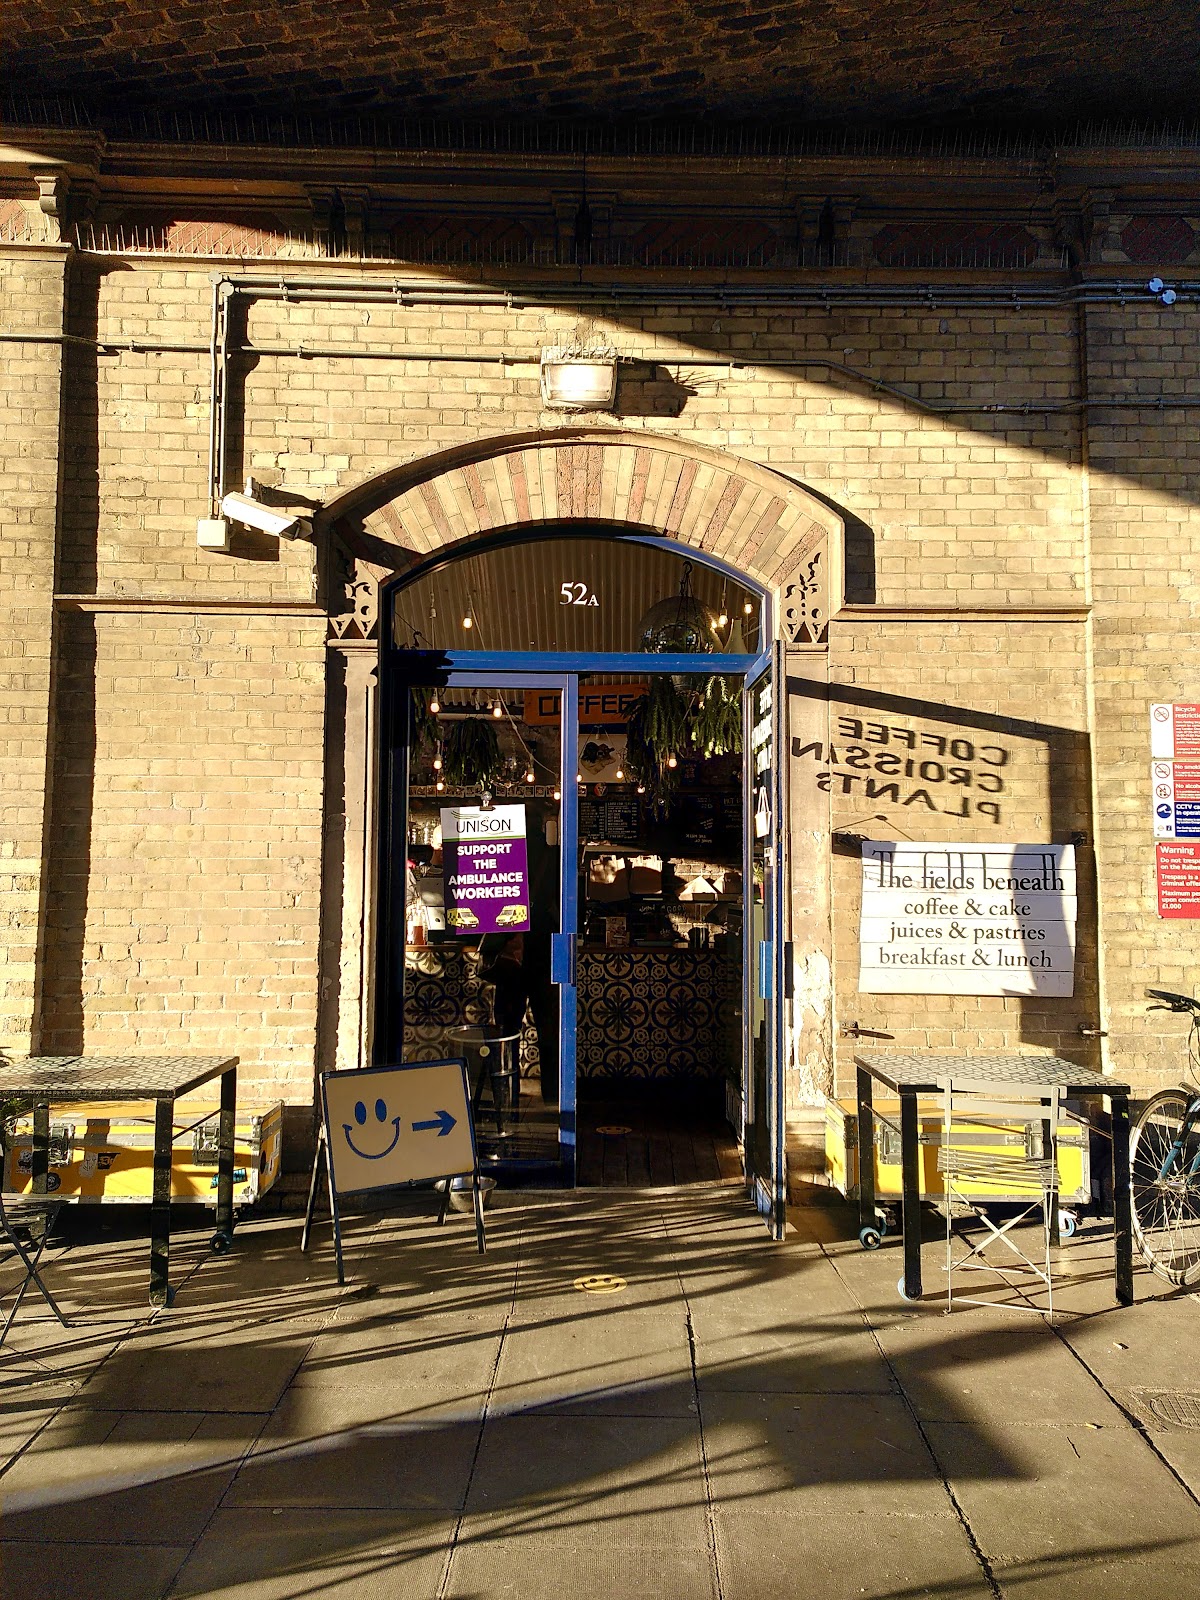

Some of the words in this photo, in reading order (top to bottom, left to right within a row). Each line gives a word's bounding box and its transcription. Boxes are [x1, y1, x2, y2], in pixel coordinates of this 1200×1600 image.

[559, 581, 600, 607] 52A
[456, 819, 511, 833] UNISON
[457, 843, 512, 857] SUPPORT
[1160, 846, 1194, 855] Warning
[473, 858, 497, 870] THE
[872, 850, 912, 888] The
[981, 852, 1065, 891] beneath
[448, 872, 524, 886] AMBULANCE
[452, 886, 521, 900] WORKERS
[904, 897, 959, 915] coffee
[964, 898, 985, 916] &
[989, 899, 1032, 916] cake
[888, 921, 943, 943] juices
[949, 921, 970, 939] &
[974, 924, 1046, 944] pastries
[879, 947, 967, 965] breakfast
[972, 948, 993, 965] &
[997, 949, 1052, 967] lunch
